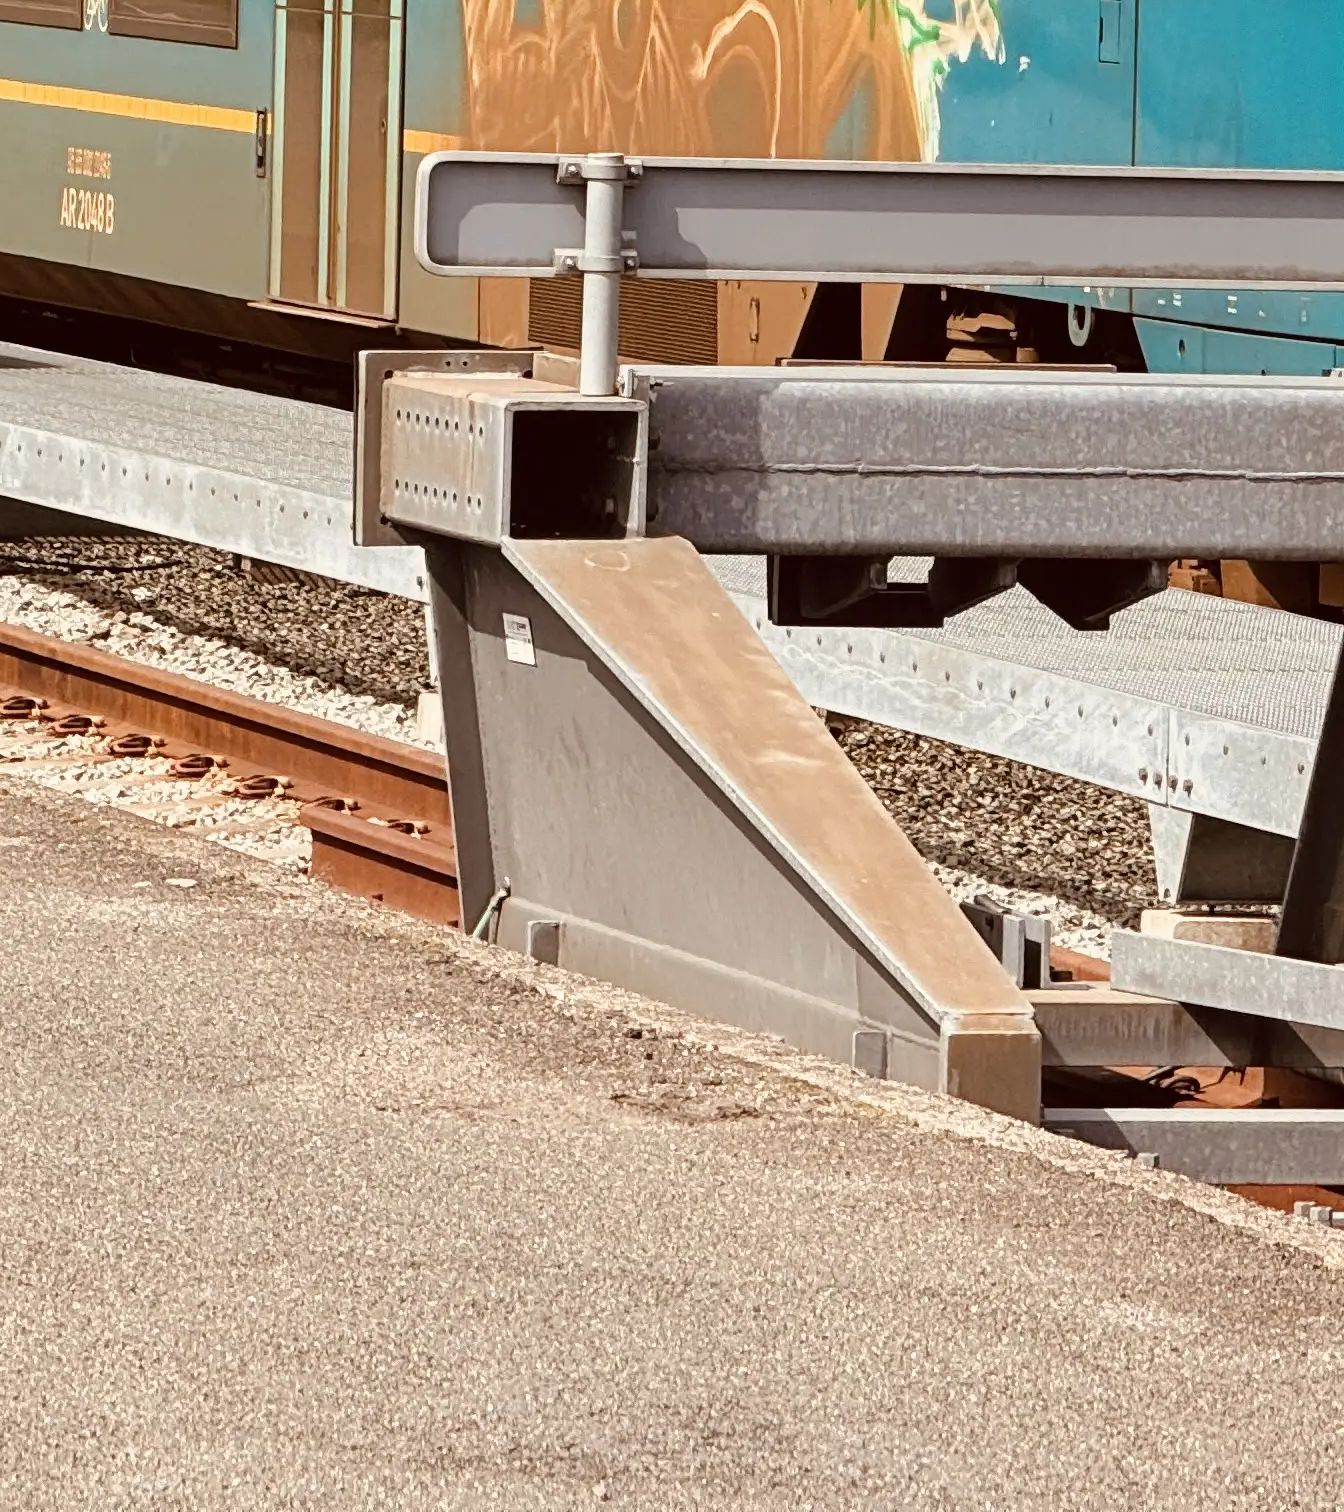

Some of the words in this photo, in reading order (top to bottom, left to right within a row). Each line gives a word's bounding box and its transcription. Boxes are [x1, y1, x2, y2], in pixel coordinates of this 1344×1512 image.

[59, 187, 77, 229] AR
[77, 189, 105, 233] 2048
[105, 193, 115, 235] B
